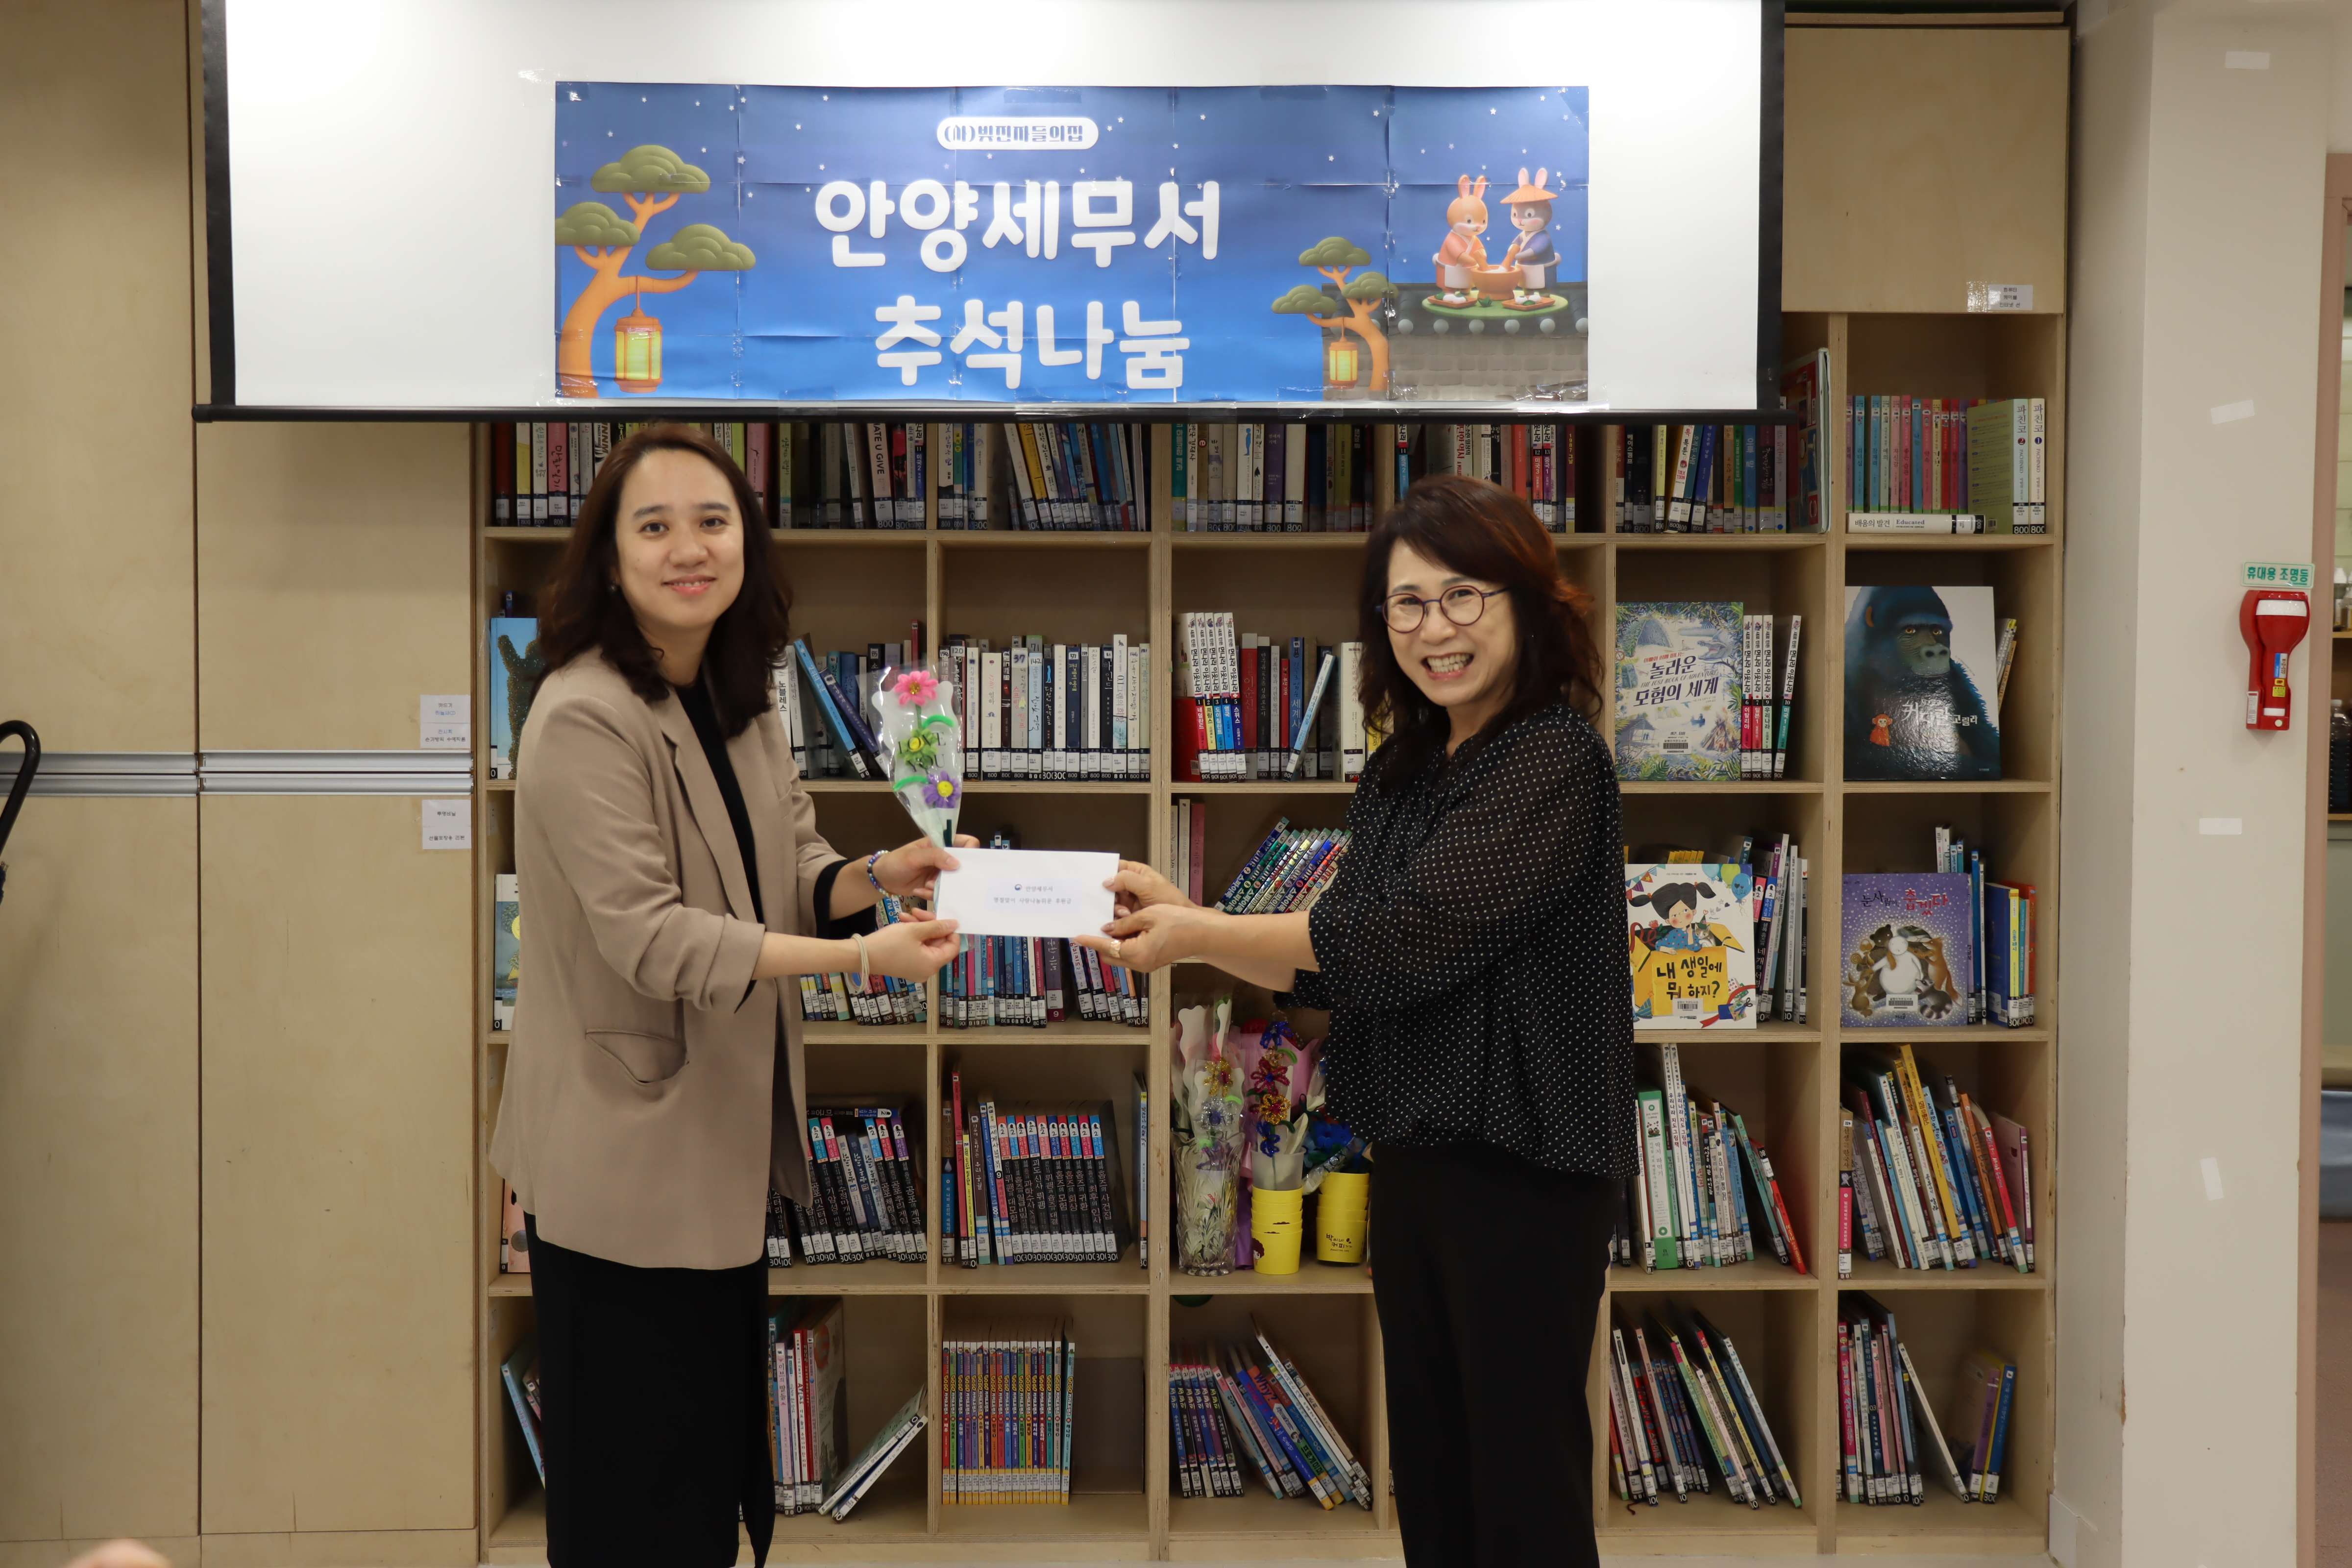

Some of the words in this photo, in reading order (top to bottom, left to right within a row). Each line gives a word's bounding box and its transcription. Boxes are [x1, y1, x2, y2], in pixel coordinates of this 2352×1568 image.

[815, 180, 1219, 272] 안양세무서
[876, 295, 1190, 389] 추석나눔
[2017, 405, 2026, 433] 파친코
[2034, 404, 2043, 432] 파친코
[876, 453, 884, 474] GIVE
[1883, 449, 1888, 461] 예의
[1287, 524, 1302, 532] 800
[2247, 567, 2276, 581] 휴대용
[2279, 568, 2308, 582] 조명등
[1031, 643, 1039, 652] 71
[1014, 655, 1025, 663] 37
[1650, 656, 1696, 679] 놀라운
[1687, 670, 1717, 680] ADVENTURE
[1786, 669, 1794, 692] 이웃나라
[1243, 676, 1254, 710] 이순신
[1633, 683, 1682, 707] 모험의
[1685, 676, 1719, 698] 세계
[1292, 699, 1301, 728] 세계사
[1755, 708, 1760, 718] 일본
[1953, 714, 1978, 726] 고릴라
[898, 732, 947, 755] LOVE
[1903, 889, 1949, 915] 춥겠다
[1657, 962, 1676, 979] 내
[1681, 956, 1722, 978] 생일에
[1756, 957, 1764, 970] 개의
[1666, 982, 1681, 1000] 뭐
[1688, 980, 1720, 999] 하지?
[1671, 1118, 1677, 1127] 지도
[1680, 1118, 1685, 1127] 지도
[1032, 1159, 1041, 1174] 괴도
[1034, 1175, 1043, 1190] 신사
[1056, 1171, 1065, 1192] 홈즈의
[1065, 1171, 1075, 1192] 홈즈의
[1076, 1170, 1085, 1192] 홈즈의
[1098, 1170, 1107, 1192] 홈즈의
[1036, 1192, 1045, 1209] 뤼팽
[1058, 1195, 1068, 1211] 모험
[1068, 1195, 1078, 1211] 회상
[1078, 1194, 1088, 1211] 귀환
[1089, 1185, 1098, 1206] 최후의
[814, 1197, 827, 1225] 미스터리
[1008, 1198, 1018, 1223] 대모험
[1092, 1208, 1101, 1224] 인사
[1102, 1194, 1112, 1220] 사건집
[1326, 1233, 1344, 1242] 박씨네
[1254, 1373, 1278, 1401] Why?
[1301, 1445, 1324, 1475] 프로게이머
